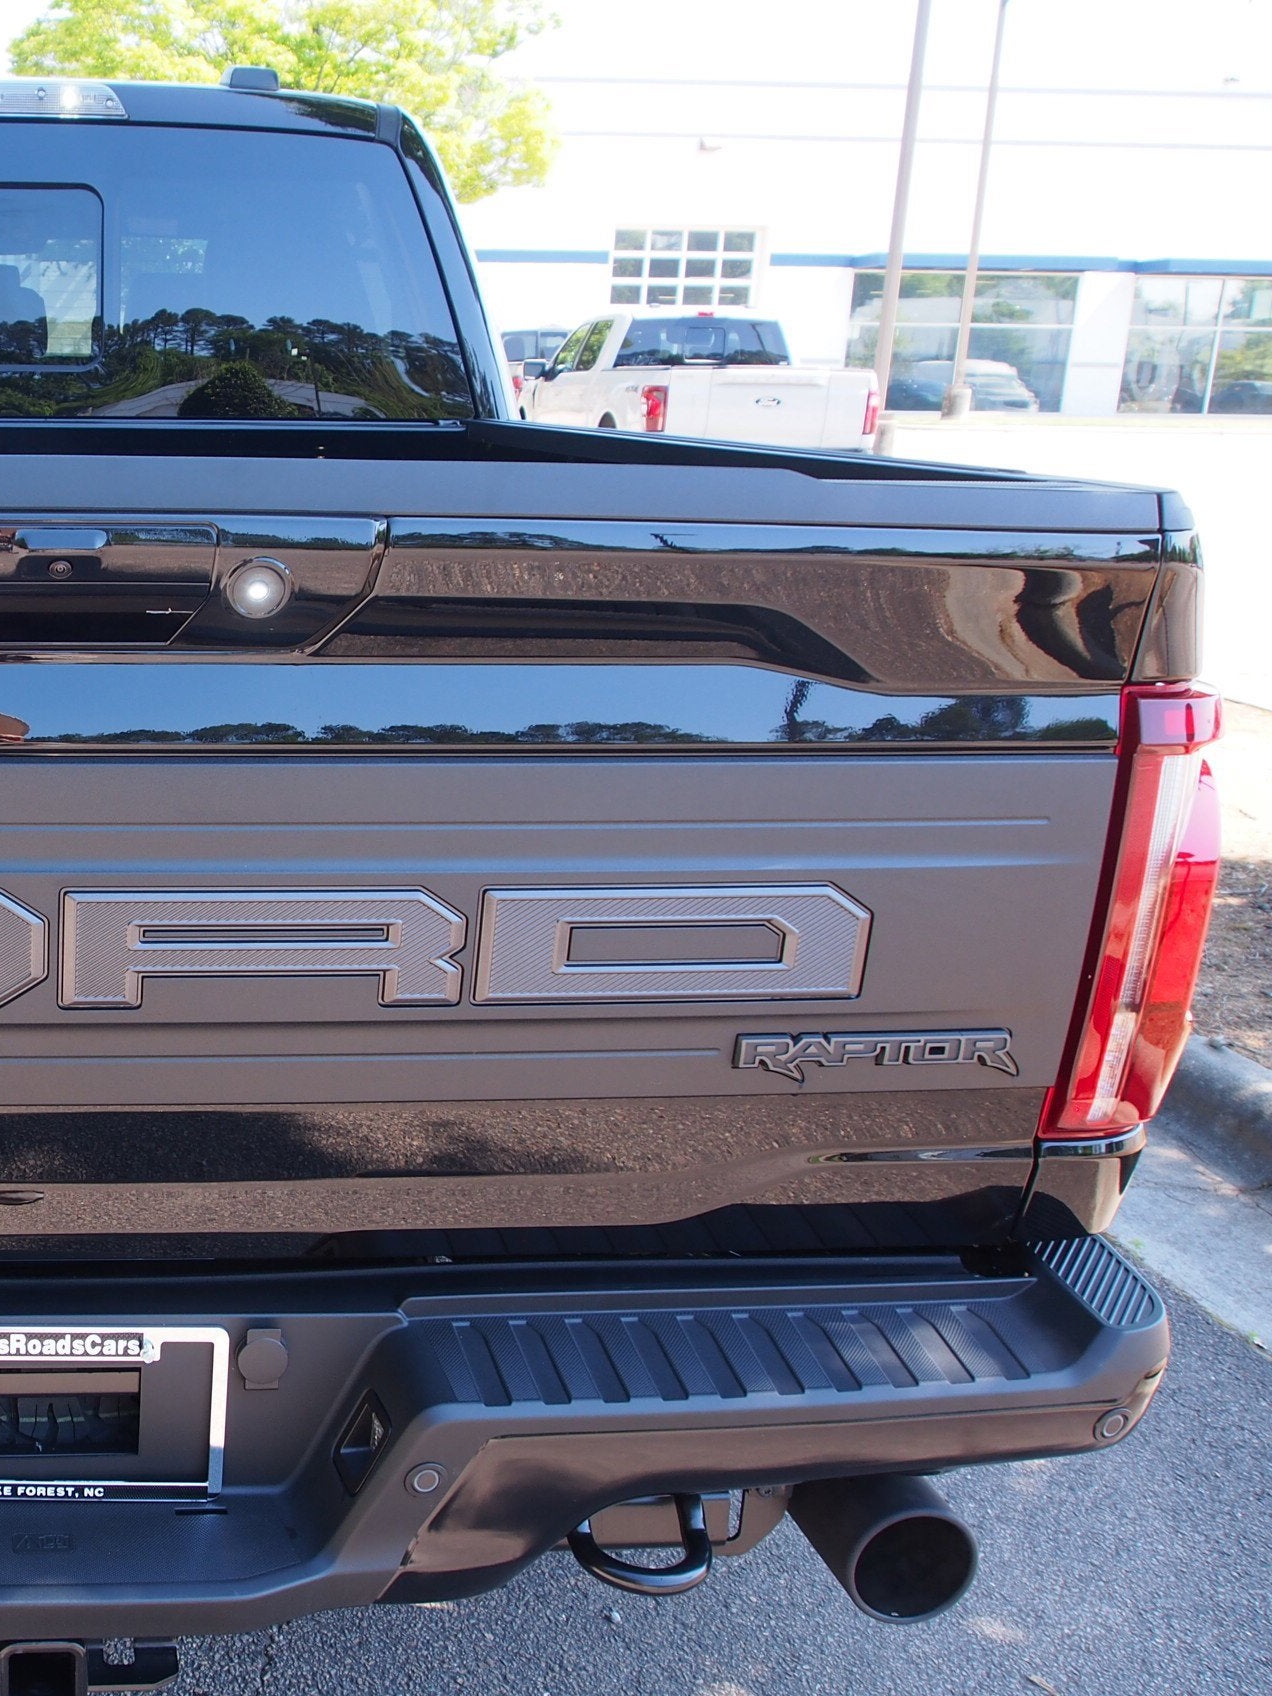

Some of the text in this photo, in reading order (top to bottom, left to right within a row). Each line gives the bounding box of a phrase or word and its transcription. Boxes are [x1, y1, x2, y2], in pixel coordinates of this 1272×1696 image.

[732, 1027, 1019, 1083] RAPTOR
[17, 1486, 79, 1498] FOREST,
[83, 1487, 105, 1498] NC
